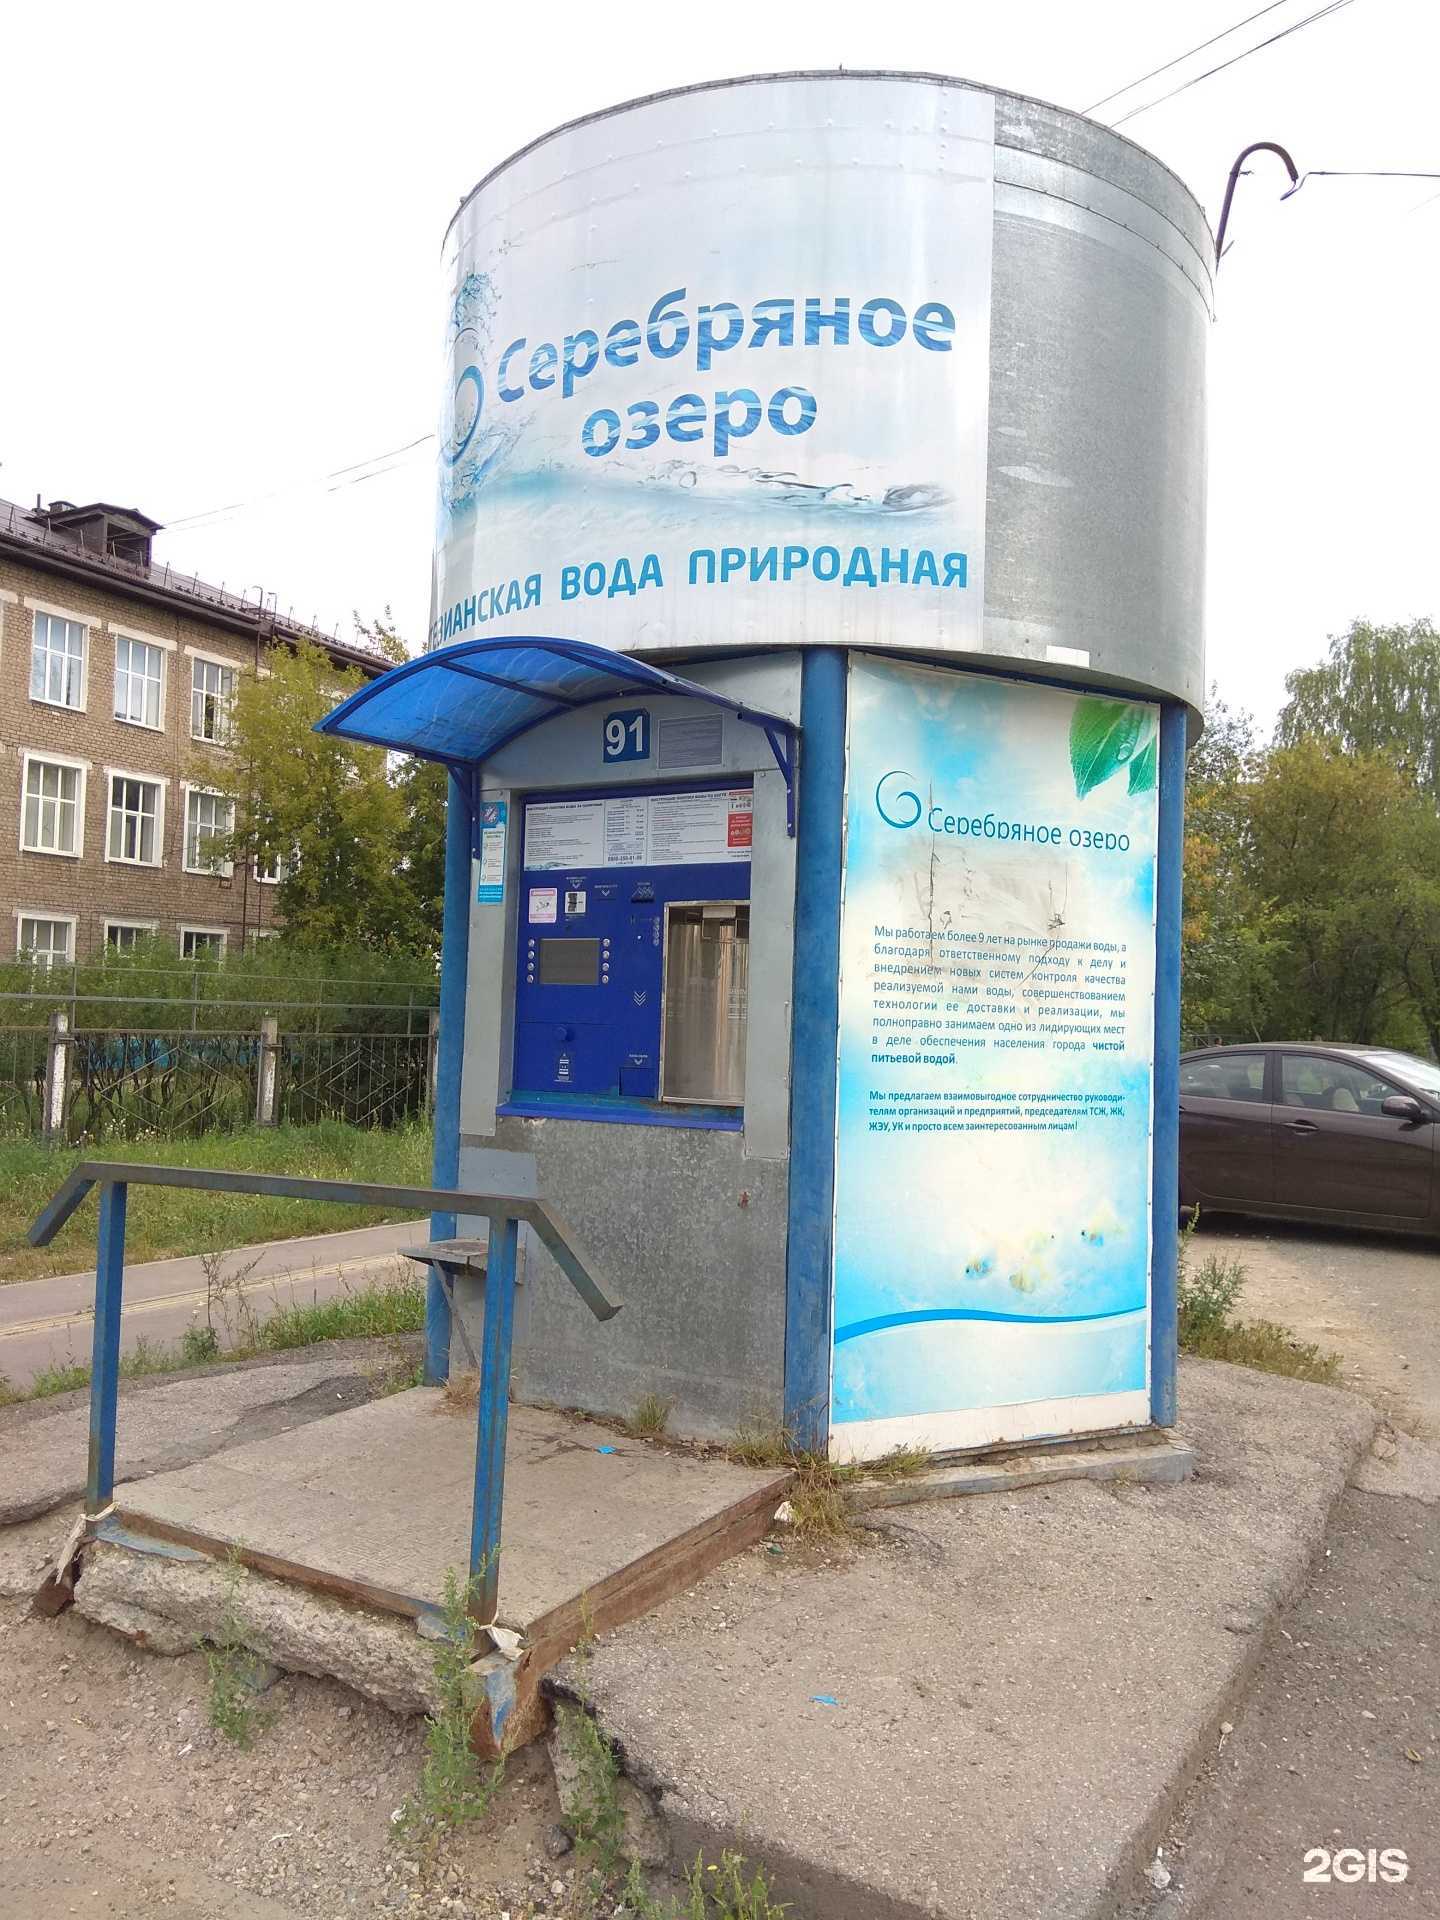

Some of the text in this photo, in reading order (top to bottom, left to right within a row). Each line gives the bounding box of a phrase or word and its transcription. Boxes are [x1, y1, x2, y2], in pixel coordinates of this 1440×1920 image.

[497, 287, 956, 402] Серебряное
[581, 386, 817, 457] озеро
[561, 554, 663, 600] ВОДА
[689, 545, 968, 588] ПРИРОДНАЯ
[606, 715, 643, 755] 91
[928, 807, 1130, 851] Серебряное озеро
[874, 926, 1127, 953] Мы работаем более 9 лет на рынке продажи воды, а
[874, 943, 1127, 970] благодаря ответственному подходу к делу и
[874, 963, 1126, 985] внедрением новых систем контроля качества
[873, 981, 1126, 1001] реализуемой нами воды, совершенствованием
[873, 1000, 1125, 1018] технологии ее доставки и реализации, мы
[873, 1018, 1125, 1035] полноправно занимаем одно из лидирующих мест
[872, 1035, 1125, 1052] в деле обеспечения населения города чистой
[871, 1052, 958, 1066] питьевой водой.
[869, 1091, 1126, 1104] Мы предлагаем взаимовыгодное сотрудничество руководи-
[869, 1106, 1125, 1118] телям организаций и предприятий, председателям ТСЖ, ЖК,
[869, 1121, 1078, 1132] ЖЭУ, УК и просто всем заинтересованным лицам!
